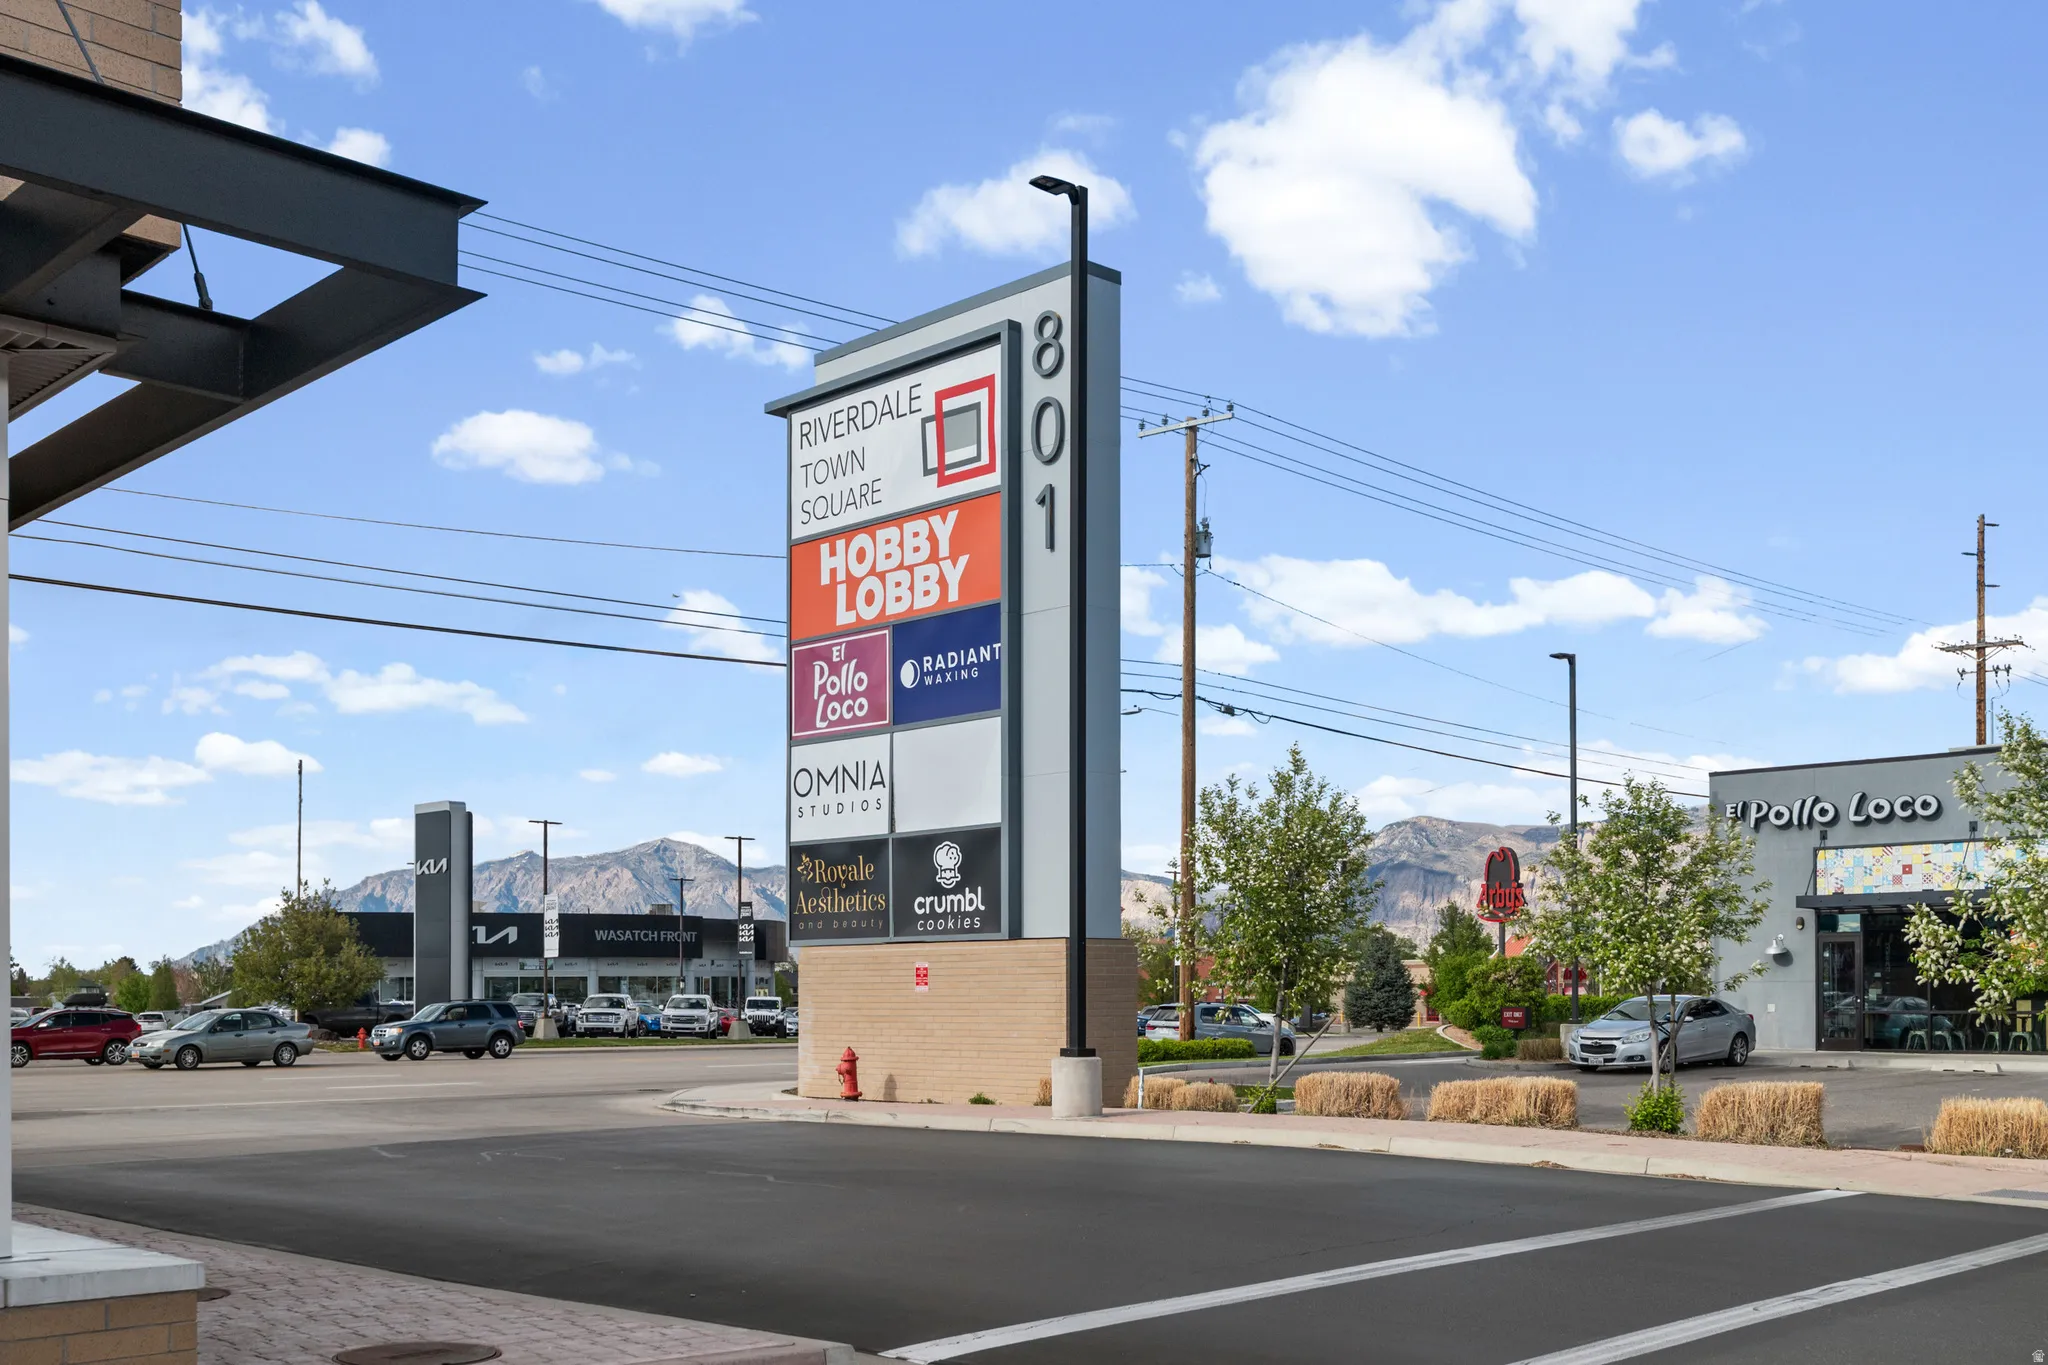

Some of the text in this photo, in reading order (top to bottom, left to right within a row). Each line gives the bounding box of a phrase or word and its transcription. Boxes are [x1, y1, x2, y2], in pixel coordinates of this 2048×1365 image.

[800, 383, 922, 450] RIVERDALE
[1031, 310, 1066, 552] 801
[800, 446, 866, 489] TOWN
[800, 478, 882, 525] SQUARE
[820, 510, 959, 586] HOBBY
[836, 554, 970, 626] LOBBY
[832, 643, 846, 662] El
[923, 643, 1001, 672] RADIANT
[813, 658, 868, 700] Pollo
[924, 667, 979, 686] WAXING
[815, 694, 869, 728] Loco
[793, 760, 886, 798] OMNIA
[797, 798, 882, 818] STUDIOS
[1725, 791, 1940, 829] El Pollo Loco
[416, 857, 448, 876] KIA
[814, 855, 874, 888] Royale
[793, 888, 886, 915] Aesthetics
[914, 886, 985, 914] crumbl
[1476, 881, 1525, 914] Arby's
[472, 925, 518, 945] IA
[594, 929, 698, 943] WASATCH FRONT
[799, 918, 884, 930] and beauty
[917, 915, 981, 931] cookies
